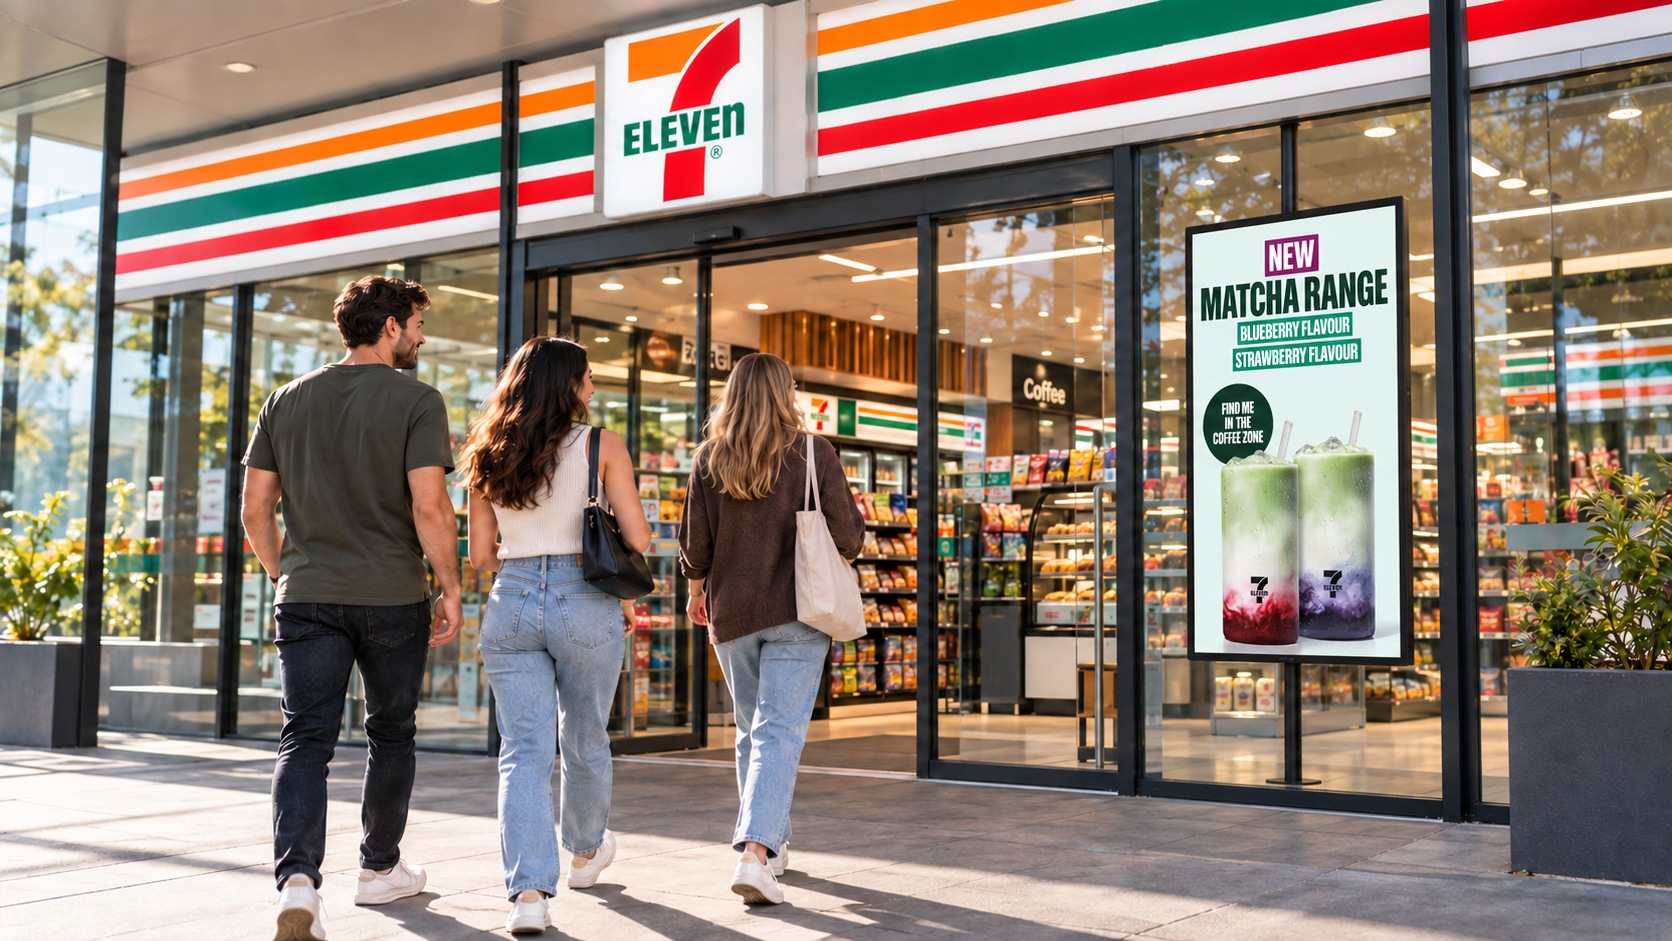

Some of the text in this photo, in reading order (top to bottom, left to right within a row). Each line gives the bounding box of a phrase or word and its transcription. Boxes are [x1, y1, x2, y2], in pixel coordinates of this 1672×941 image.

[627, 17, 741, 203] 7
[1268, 239, 1315, 272] NEW
[1200, 268, 1389, 322] MATCHA RANGE
[1240, 317, 1350, 342] BLUEBERRY FLAVOUR
[1235, 343, 1358, 369] STRAWBERRY FLAVOUR
[1023, 377, 1066, 405] Coffee
[1221, 401, 1255, 415] FIND ME
[1224, 416, 1252, 430] IN THE
[1212, 430, 1264, 445] COFFEE ZONE
[1250, 576, 1269, 604] 7
[1323, 570, 1343, 599] 7
